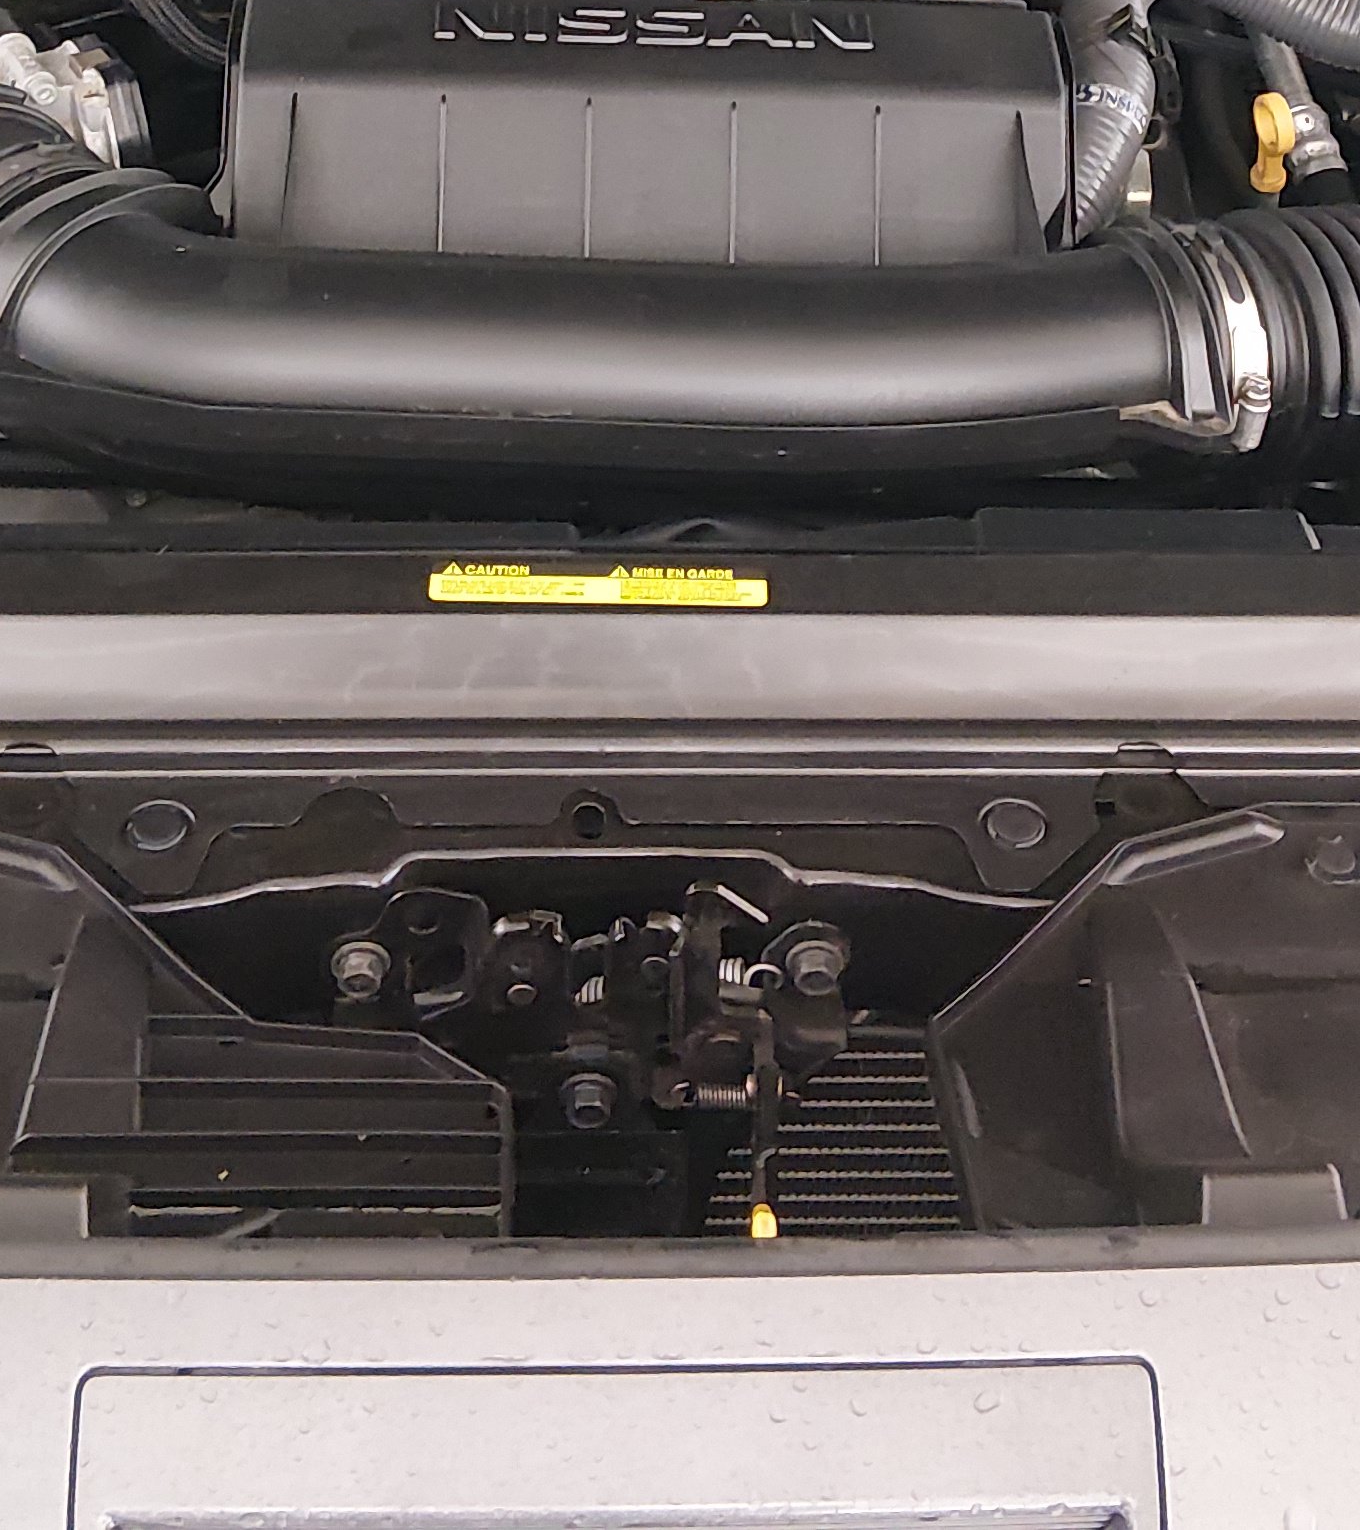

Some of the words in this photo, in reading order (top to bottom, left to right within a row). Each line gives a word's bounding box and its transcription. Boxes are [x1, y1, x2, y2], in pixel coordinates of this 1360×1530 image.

[434, 2, 875, 50] NISSAN
[464, 564, 530, 576] CAUTION
[666, 567, 685, 579] EN
[686, 568, 734, 581] GARDE
